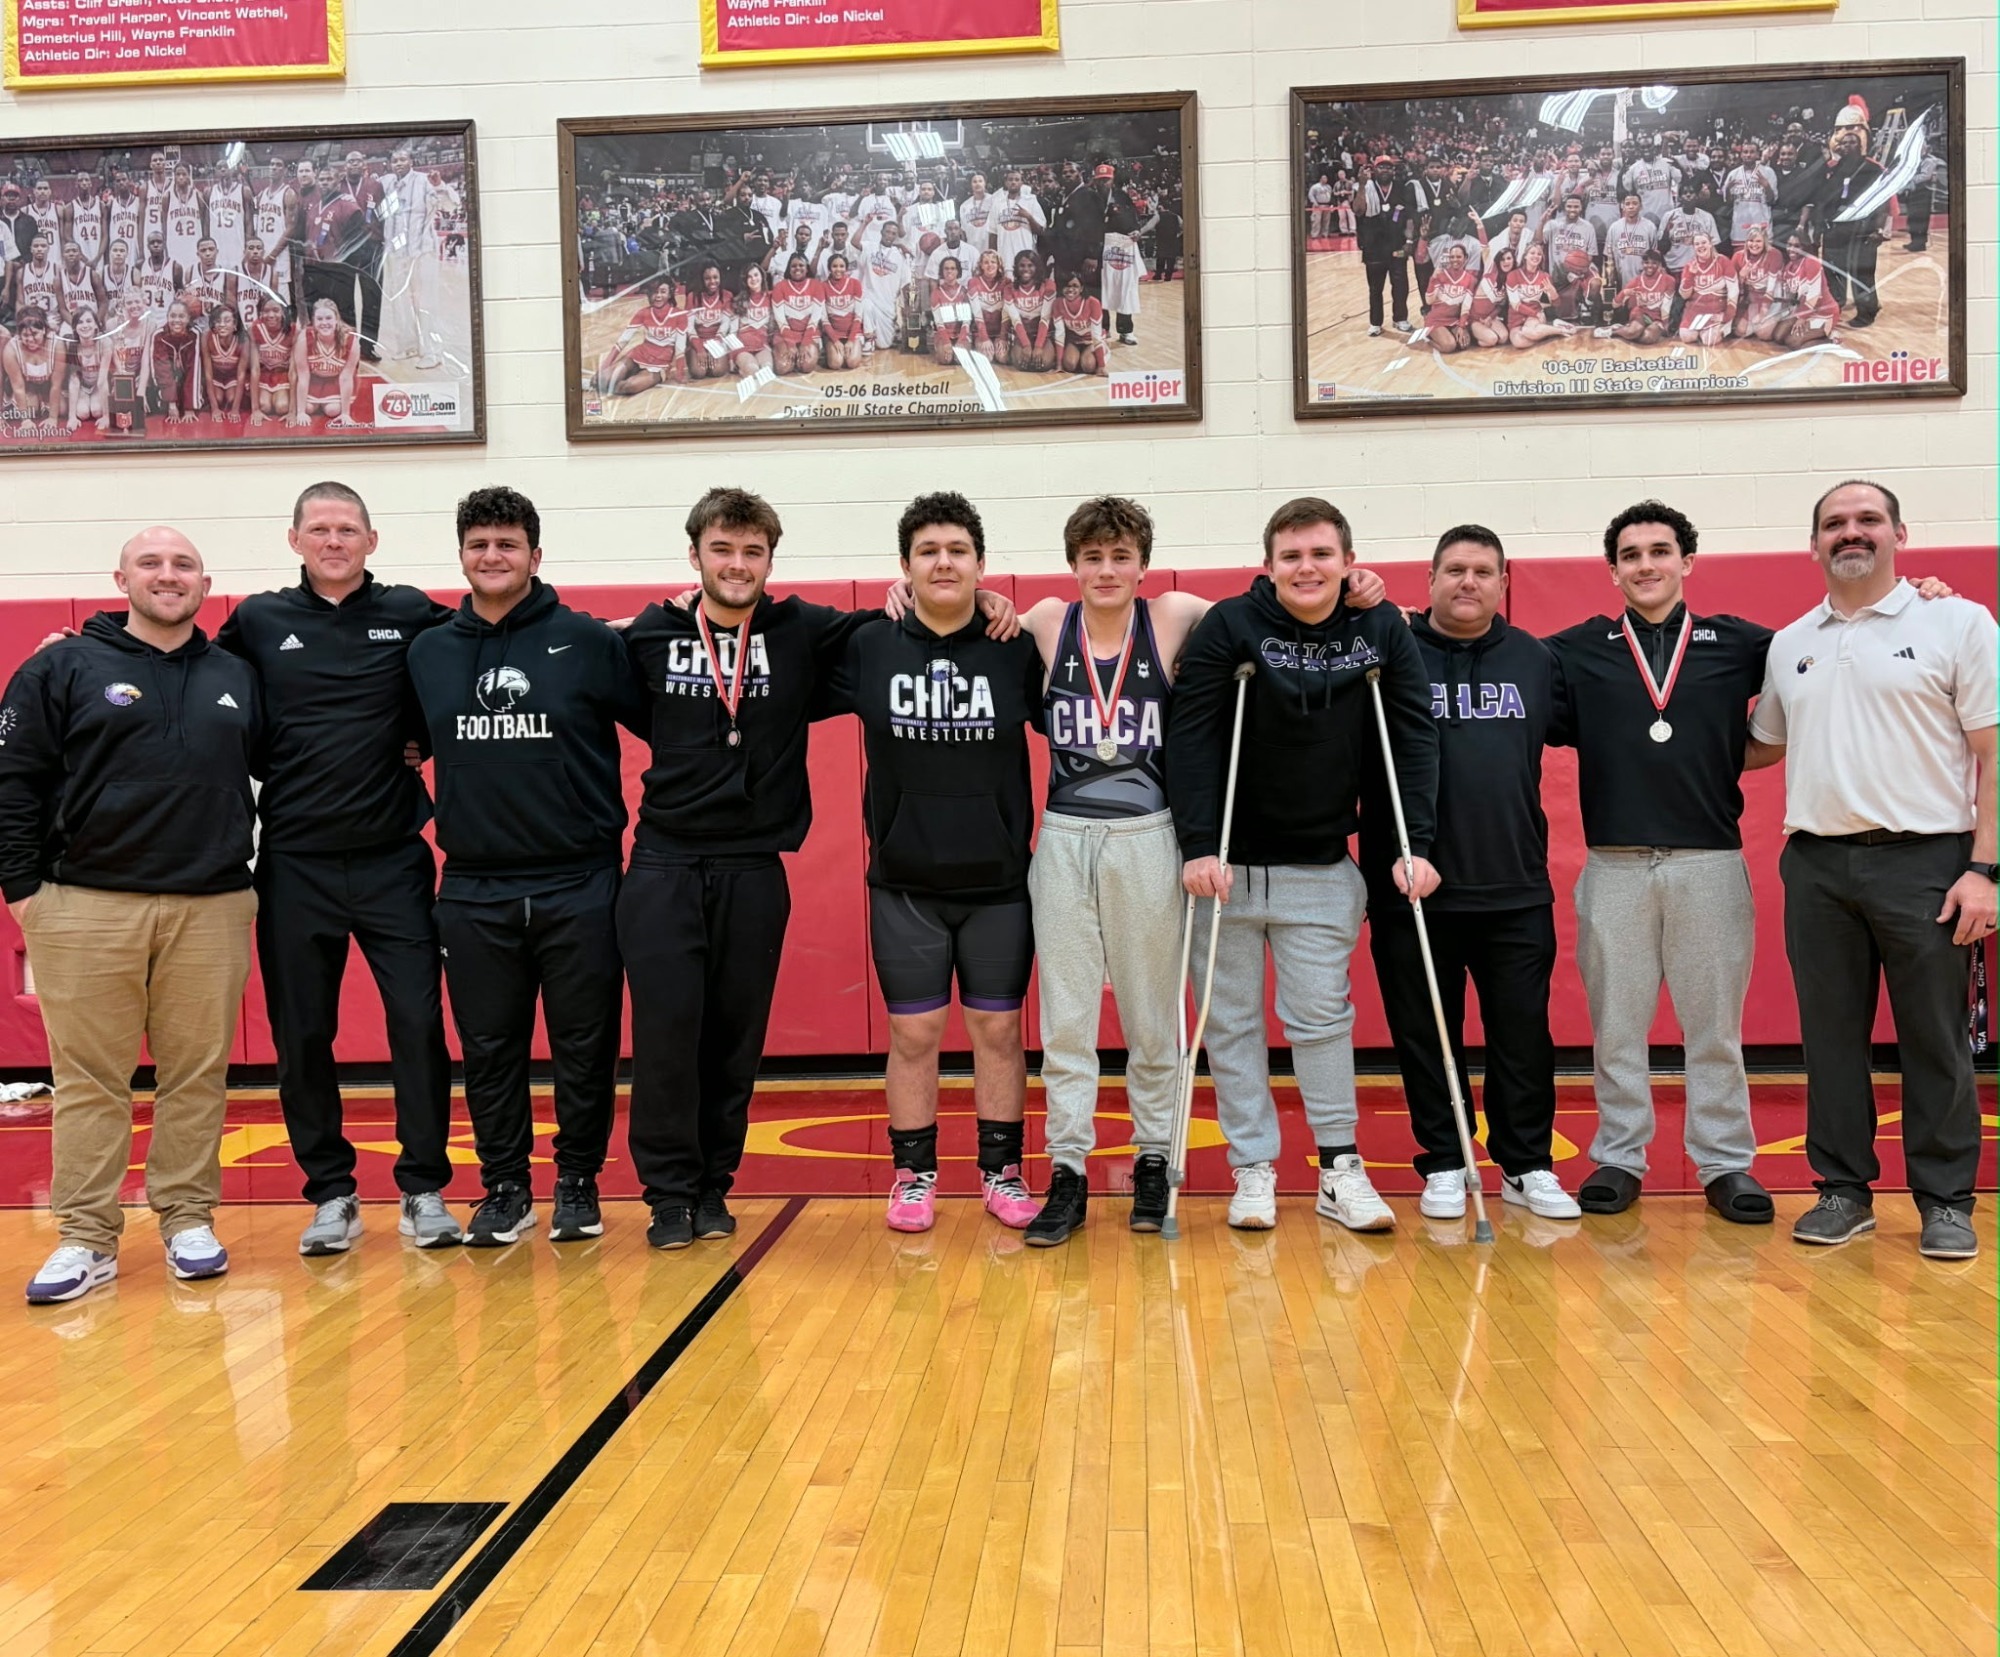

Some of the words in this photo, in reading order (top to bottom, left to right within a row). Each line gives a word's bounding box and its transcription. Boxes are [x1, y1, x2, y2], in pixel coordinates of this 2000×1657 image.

[727, 0, 770, 10] Wayne
[22, 15, 65, 29] Mgrs:
[69, 11, 115, 26] Travell
[120, 11, 171, 25] Harper,
[176, 8, 232, 21] Vincent
[235, 6, 288, 20] Wathel,
[727, 15, 781, 28] Athletic
[785, 13, 810, 25] Dir:
[815, 12, 839, 24] Joe
[843, 8, 884, 22] Nickel
[22, 32, 96, 45] Demetrius
[100, 29, 126, 43] Hill,
[131, 28, 176, 41] Wayne
[179, 25, 235, 38] Franklin
[24, 48, 80, 62] Athletic
[84, 47, 110, 60] Dir:
[115, 46, 140, 58] Joe
[144, 43, 187, 57] Nickel
[80, 225, 98, 241] 44
[117, 223, 135, 240] 40
[175, 219, 196, 237] 42
[144, 289, 165, 309] 34
[788, 294, 812, 305] NCH
[829, 294, 852, 306] NCH
[1602, 356, 1697, 372] Basketball
[1844, 351, 1941, 383] meijer
[872, 381, 950, 396] Basketball
[1111, 375, 1182, 404] meijer
[1494, 381, 1564, 396] Division
[1569, 379, 1589, 393] III
[1594, 377, 1643, 392] State
[1649, 374, 1749, 392] Champions
[864, 403, 903, 416] State
[3, 425, 73, 441] Champions
[367, 629, 402, 640] CHCA
[1692, 629, 1718, 642] CHCA
[667, 633, 771, 677] CHCA
[888, 673, 996, 719] CHCA
[1429, 683, 1526, 719] CHCA
[456, 713, 554, 740] FOOTBALL
[1052, 698, 1164, 747] CHCA
[891, 723, 995, 741] WRESTLING
